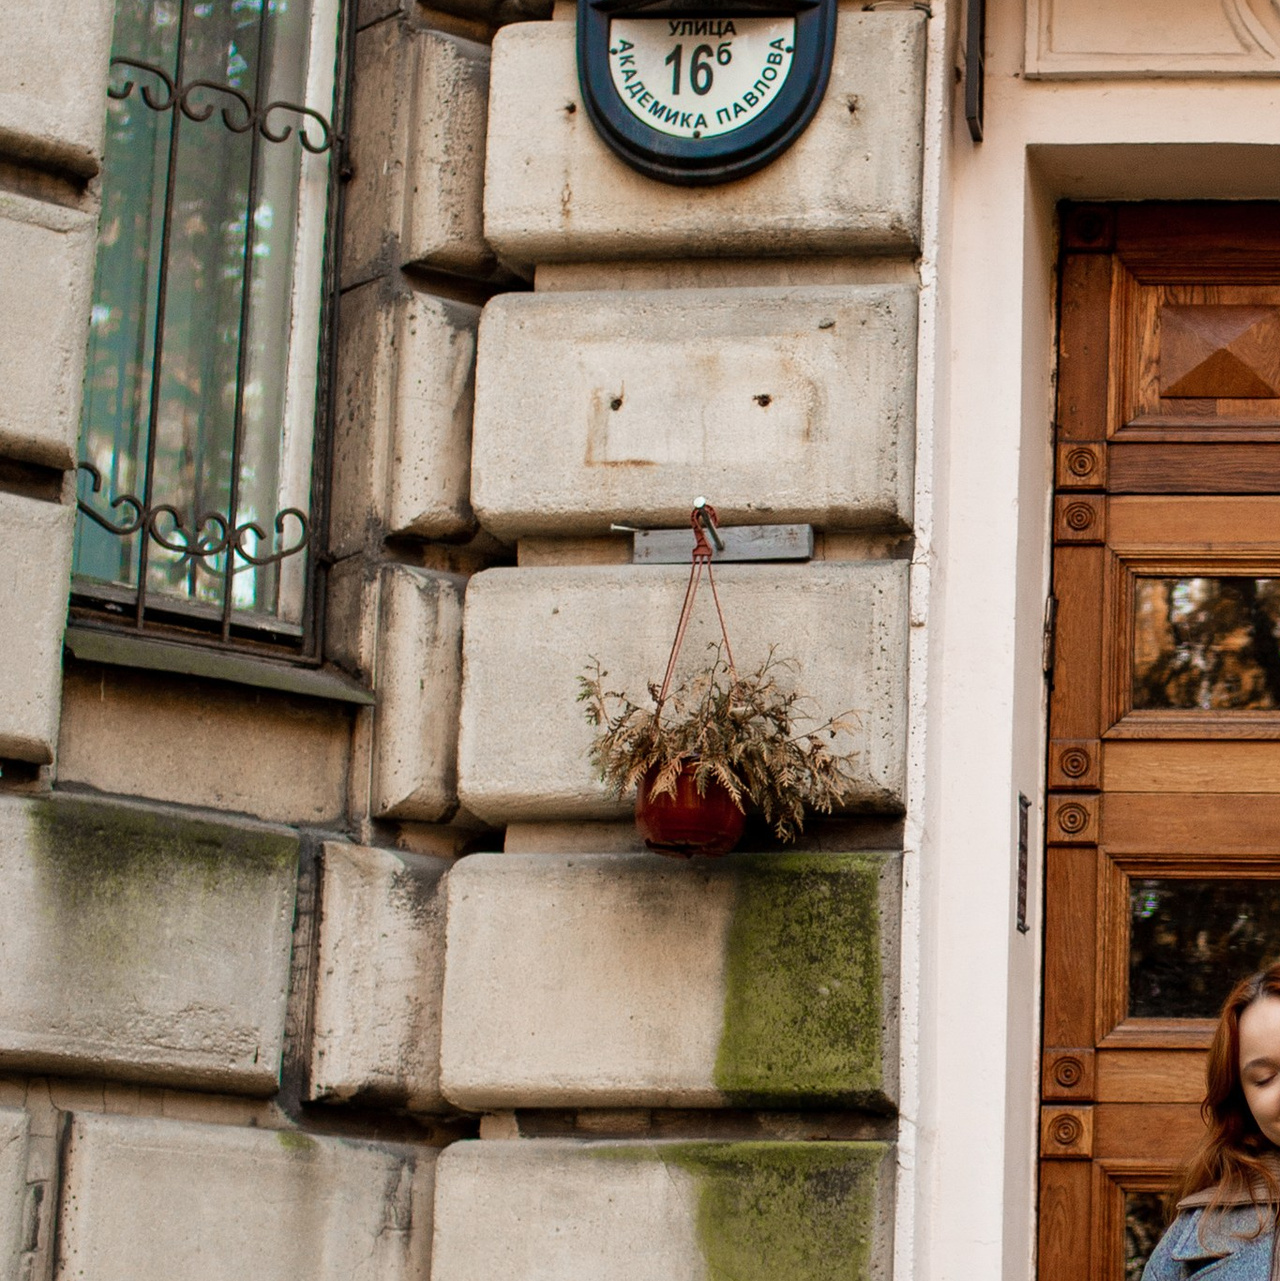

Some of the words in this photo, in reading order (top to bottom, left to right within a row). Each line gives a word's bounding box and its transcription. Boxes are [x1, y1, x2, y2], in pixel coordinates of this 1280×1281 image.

[668, 20, 737, 38] УЛИЦА
[618, 38, 708, 129] АКАДЕМИКА
[715, 37, 785, 125] ПАВЛОВА
